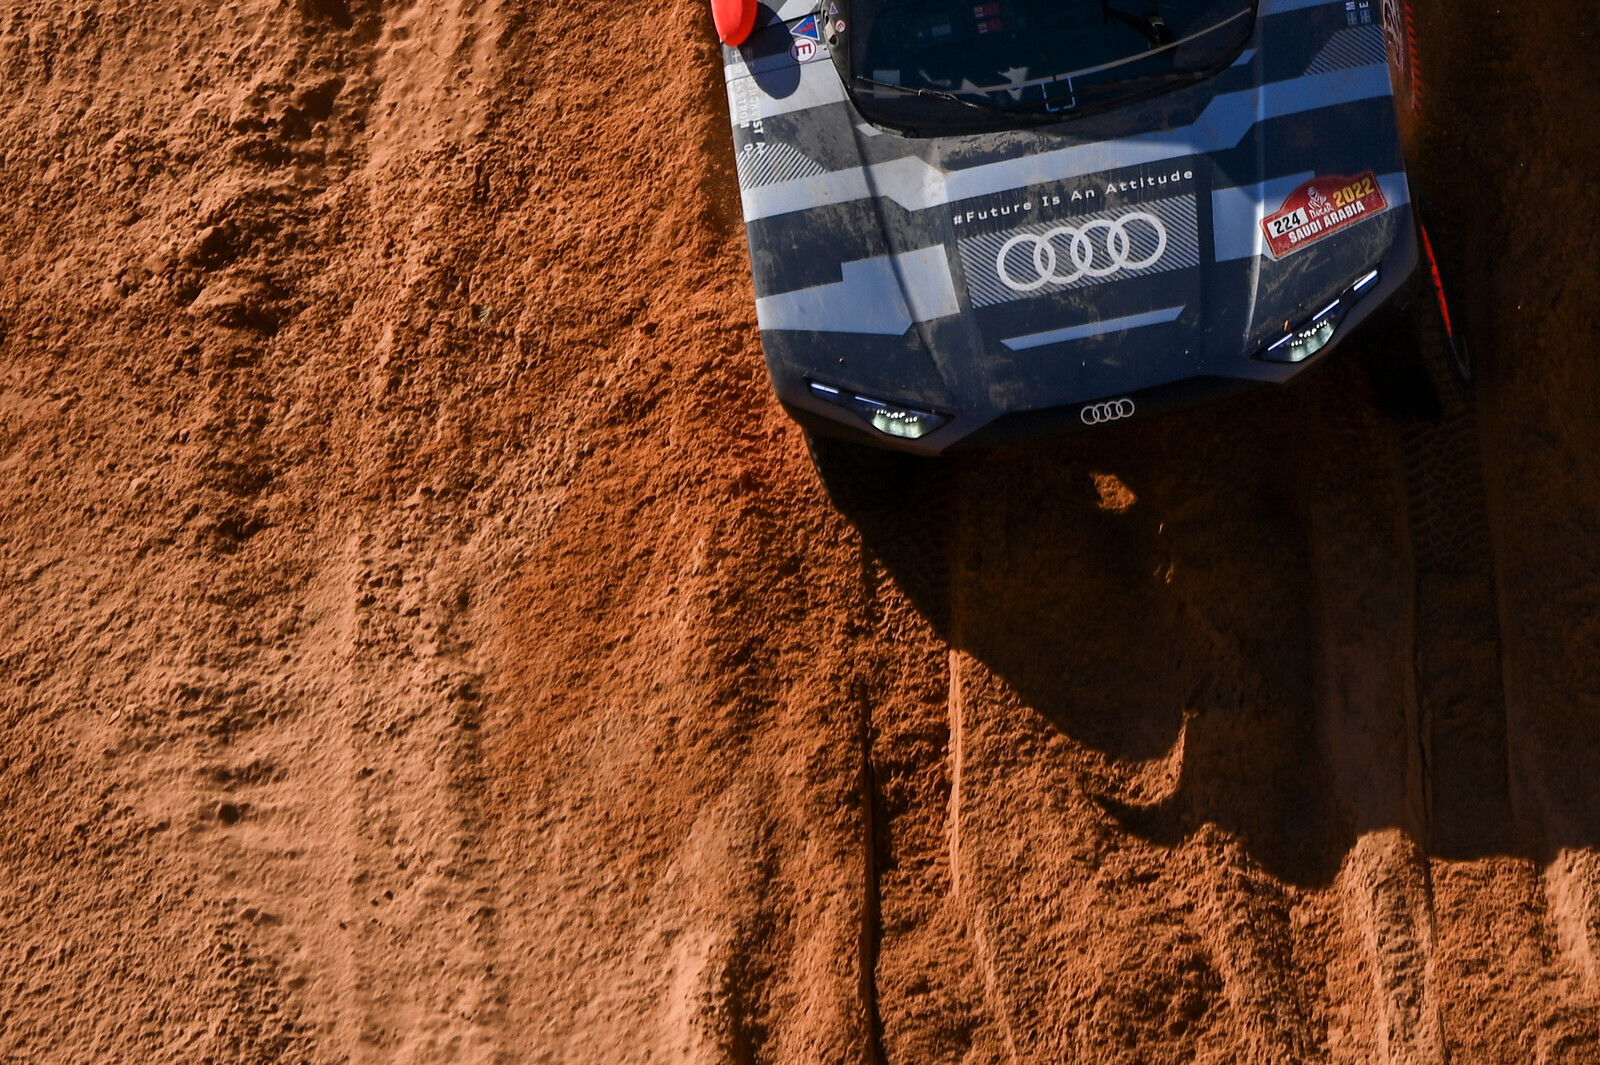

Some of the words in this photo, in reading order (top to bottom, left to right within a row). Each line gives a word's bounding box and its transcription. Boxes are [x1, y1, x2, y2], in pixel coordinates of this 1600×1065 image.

[796, 43, 812, 57] E
[952, 202, 1032, 226] #Future
[1042, 195, 1061, 207] Is
[1070, 188, 1095, 202] An
[1105, 169, 1194, 195] Attitude
[1332, 177, 1375, 208] 2022
[1273, 212, 1301, 235] 224
[1288, 220, 1323, 244] SAUDI
[1323, 200, 1366, 228] ARABIA
